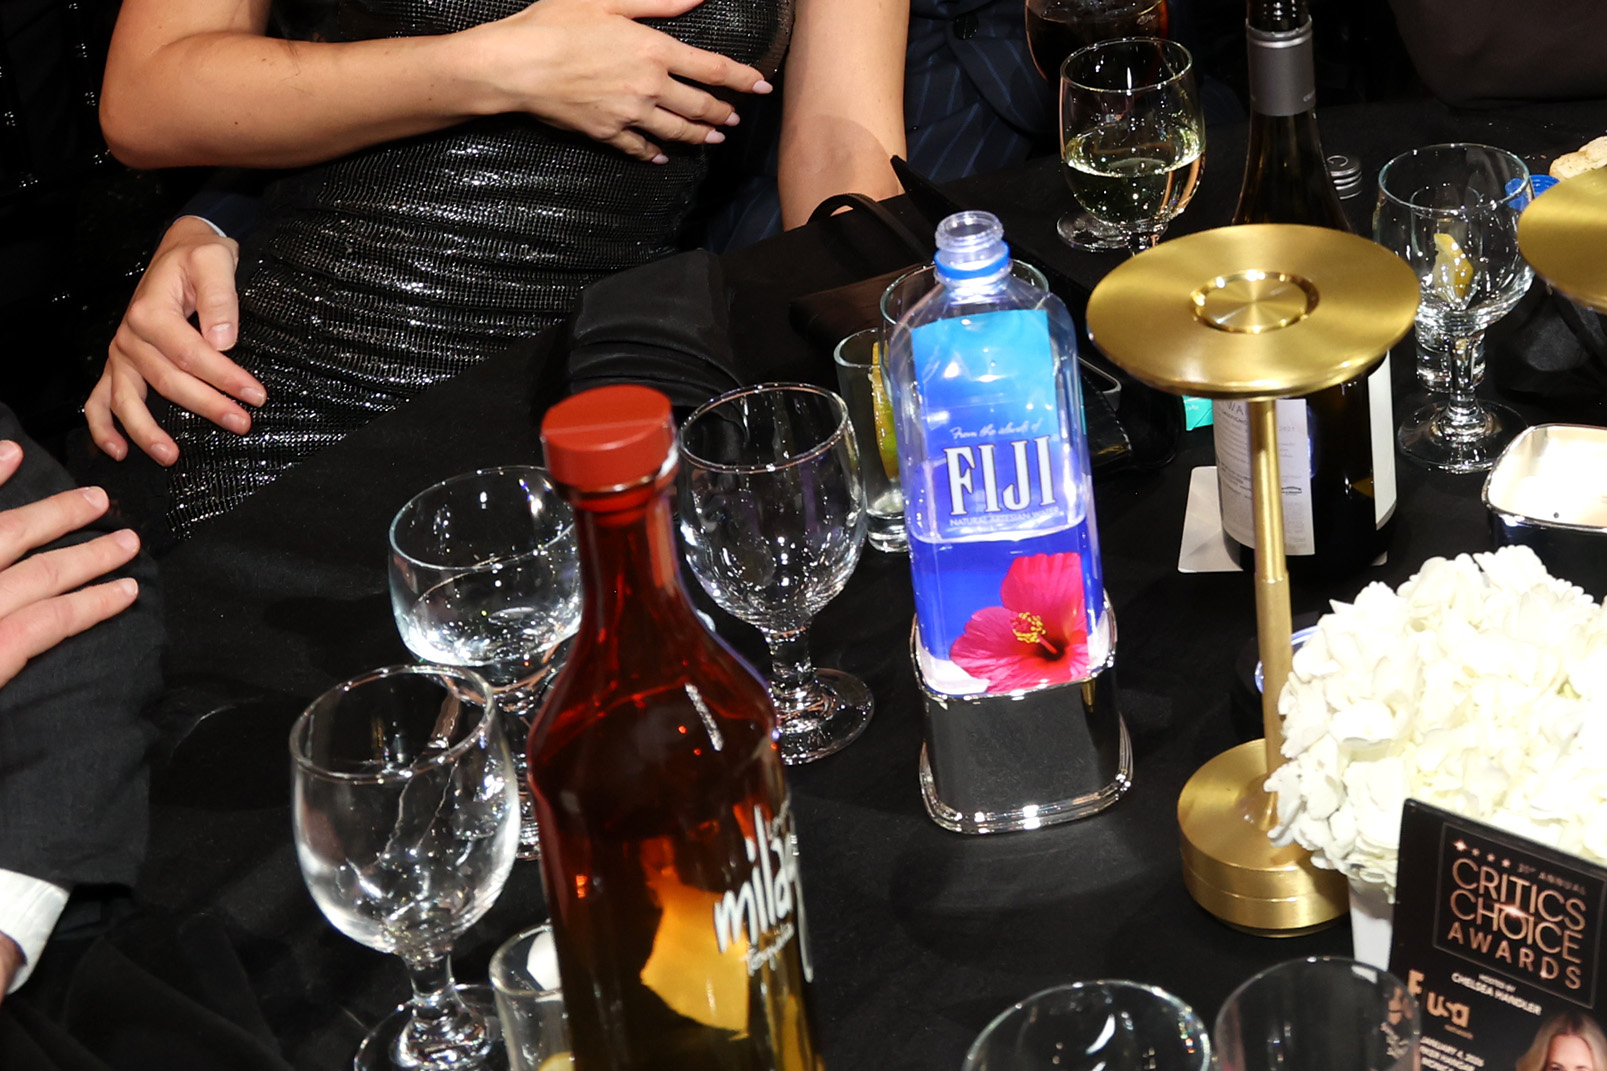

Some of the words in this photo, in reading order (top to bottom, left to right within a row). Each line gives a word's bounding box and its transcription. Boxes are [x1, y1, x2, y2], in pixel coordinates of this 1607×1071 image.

[979, 423, 997, 437] the
[943, 435, 1057, 516] FIJI
[949, 516, 988, 527] NATURAL
[1450, 889, 1584, 964] CHOICE
[1452, 858, 1587, 931] CRITICS
[1447, 921, 1582, 989] AWARDS
[1451, 972, 1494, 996] CHELSEA
[1494, 987, 1543, 1016] HANDLER
